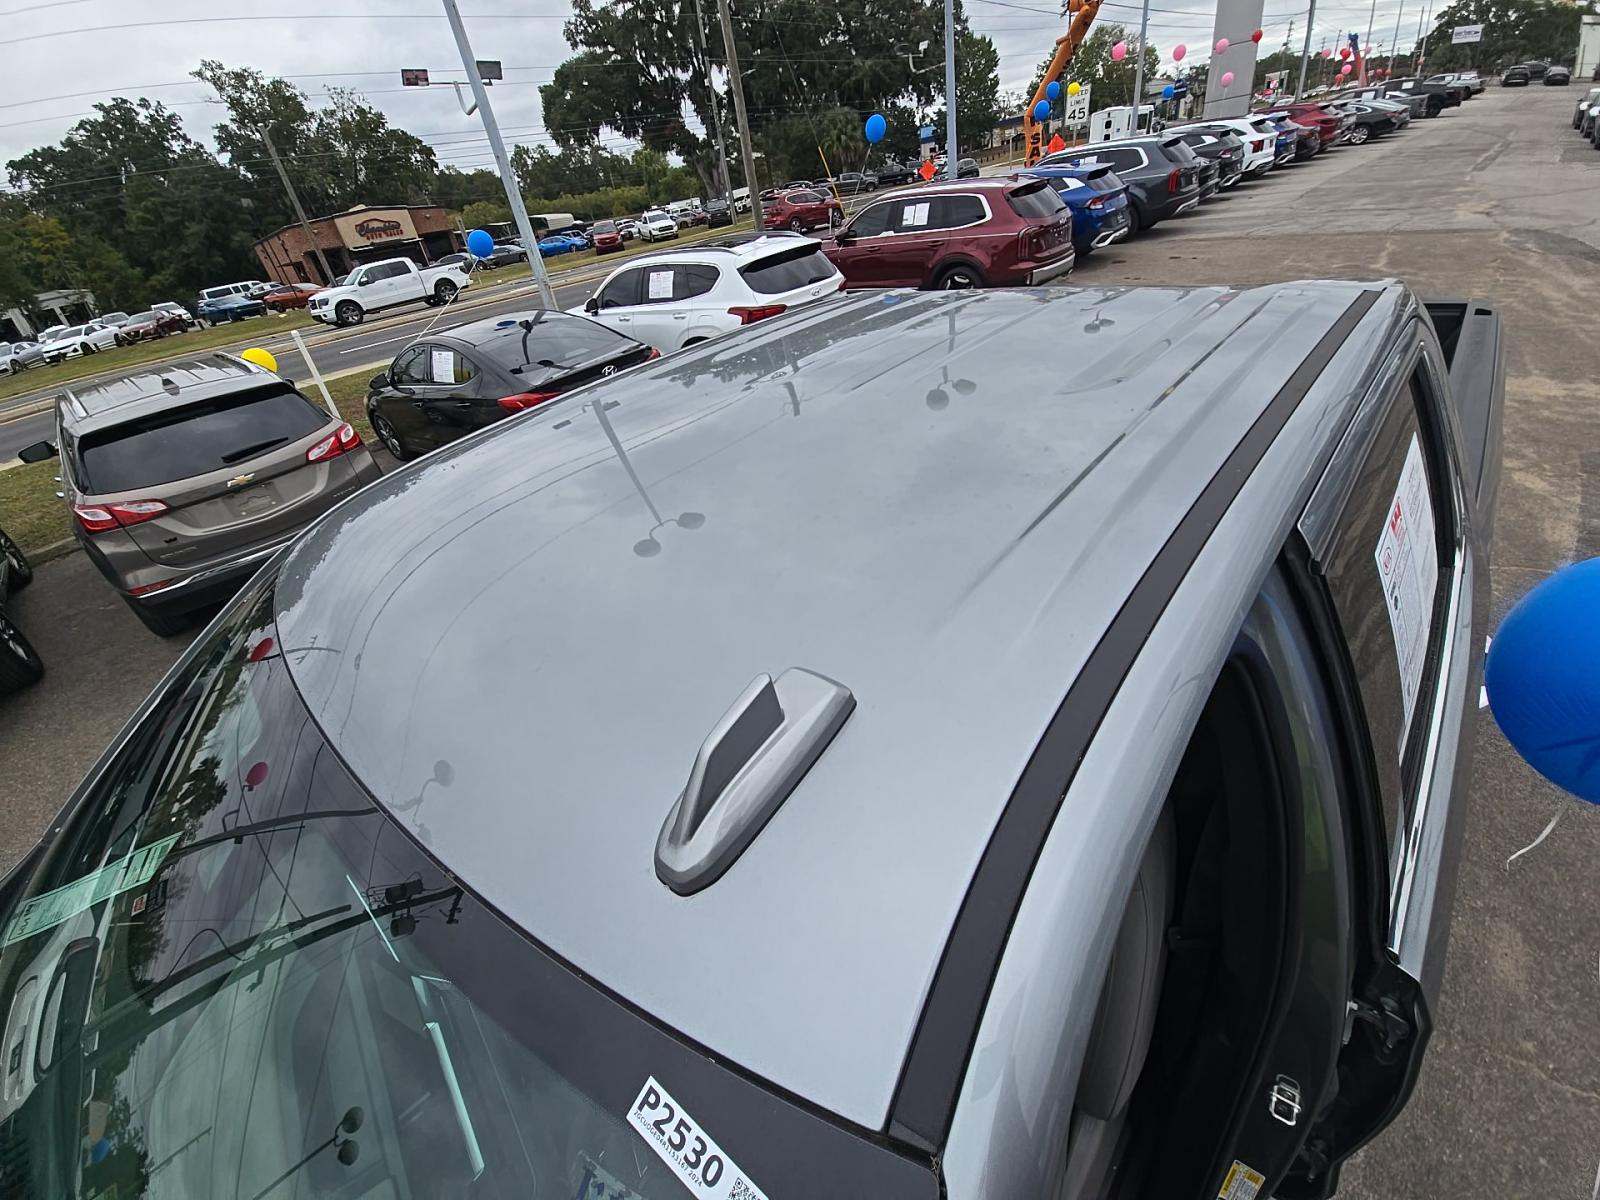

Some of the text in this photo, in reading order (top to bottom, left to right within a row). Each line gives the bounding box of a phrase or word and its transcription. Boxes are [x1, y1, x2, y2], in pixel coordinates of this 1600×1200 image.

[1070, 98, 1086, 107] LIMIT
[1067, 107, 1086, 120] 45
[637, 1085, 724, 1188] P2530
[688, 1171, 703, 1187] 2024
